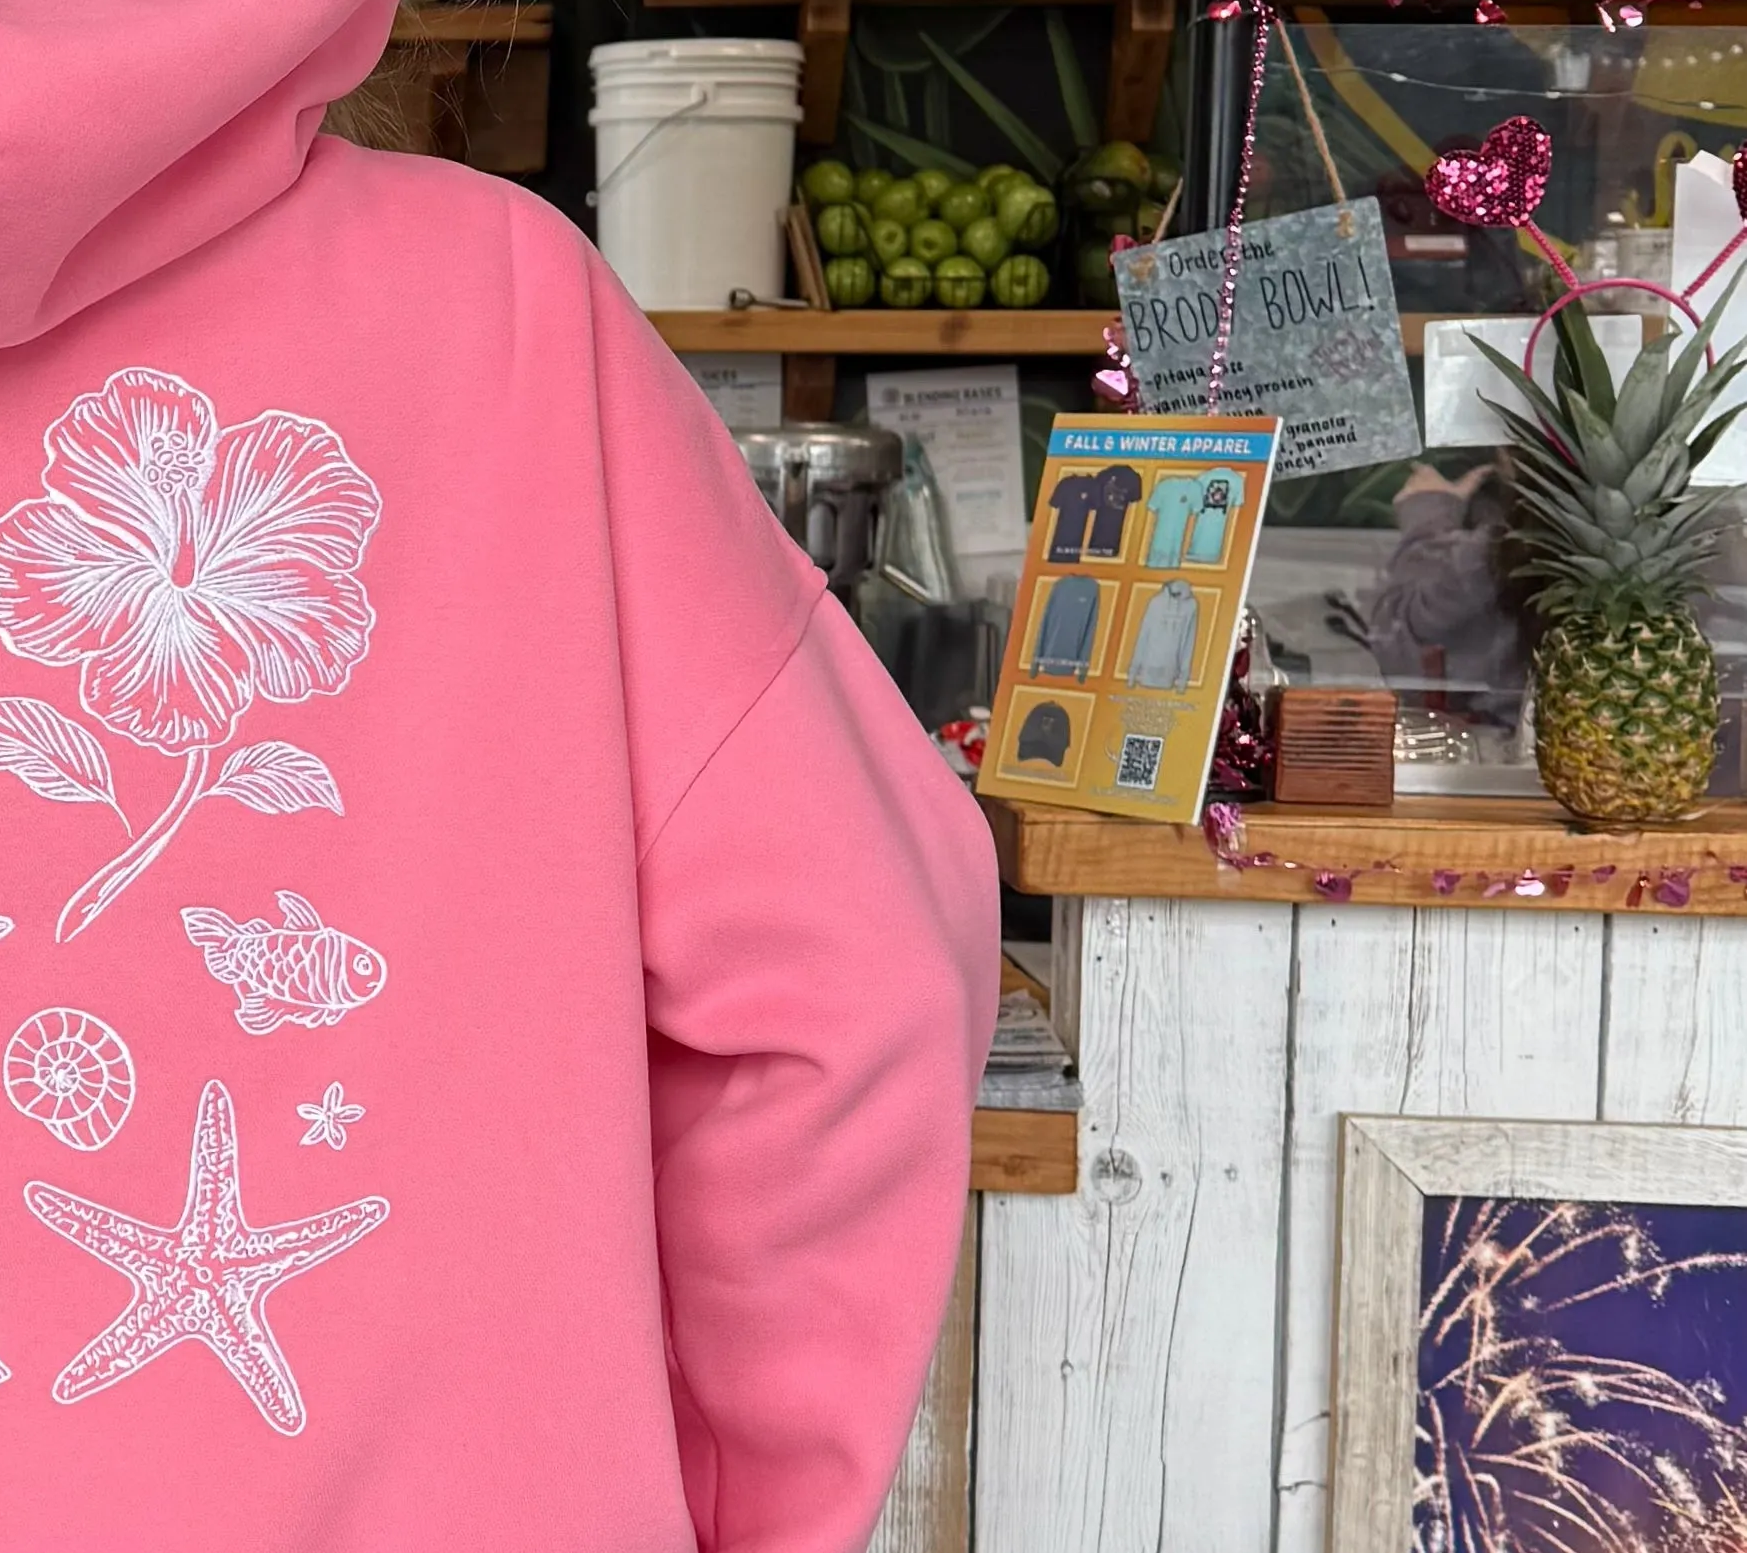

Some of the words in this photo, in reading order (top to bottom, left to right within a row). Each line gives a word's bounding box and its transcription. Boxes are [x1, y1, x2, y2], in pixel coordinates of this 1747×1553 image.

[1240, 239, 1275, 261] the
[1260, 256, 1376, 331] BOWL!
[1255, 376, 1315, 399] protein
[1065, 435, 1099, 450] FALL
[1104, 436, 1115, 450] &
[1120, 436, 1176, 453] WINTER
[1180, 437, 1252, 454] APPAREL
[1274, 451, 1323, 473] oney!
